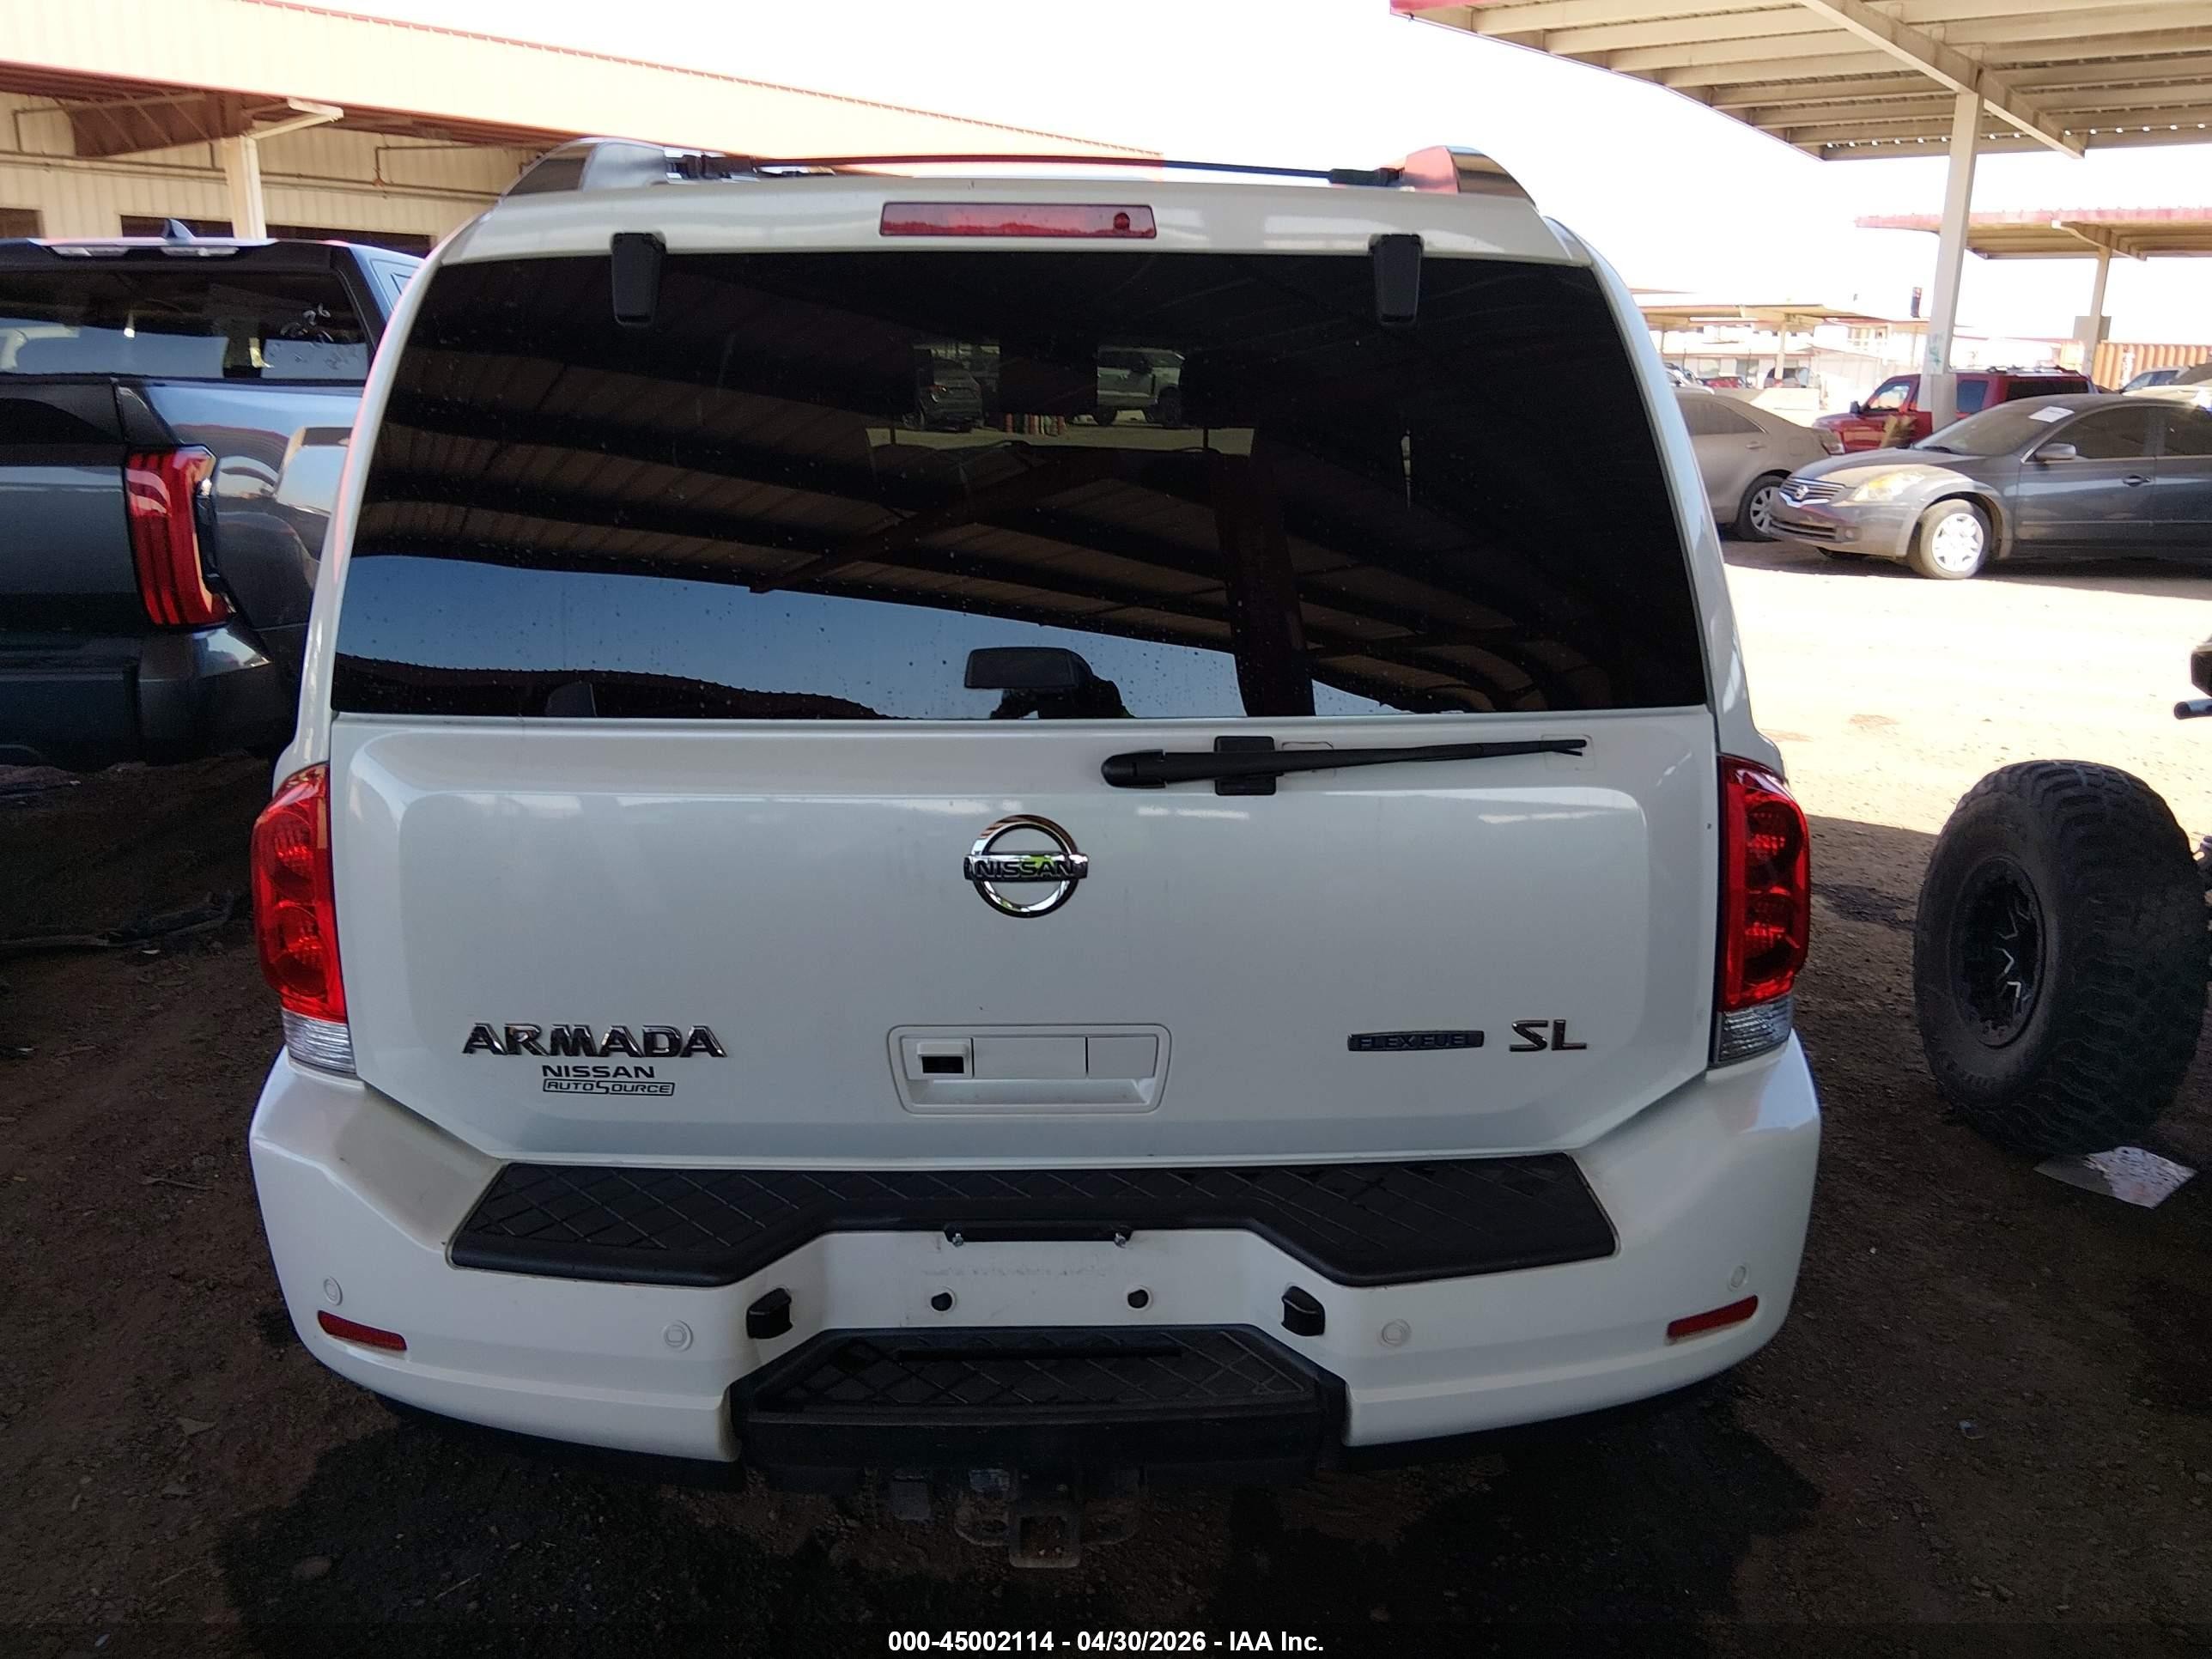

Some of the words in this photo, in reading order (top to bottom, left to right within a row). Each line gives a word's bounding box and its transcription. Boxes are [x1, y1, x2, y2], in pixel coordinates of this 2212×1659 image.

[975, 859, 1074, 878] NISSAN
[461, 1022, 728, 1058] ARMADA
[1509, 1018, 1588, 1052] SL
[542, 1064, 655, 1079] NISSAN
